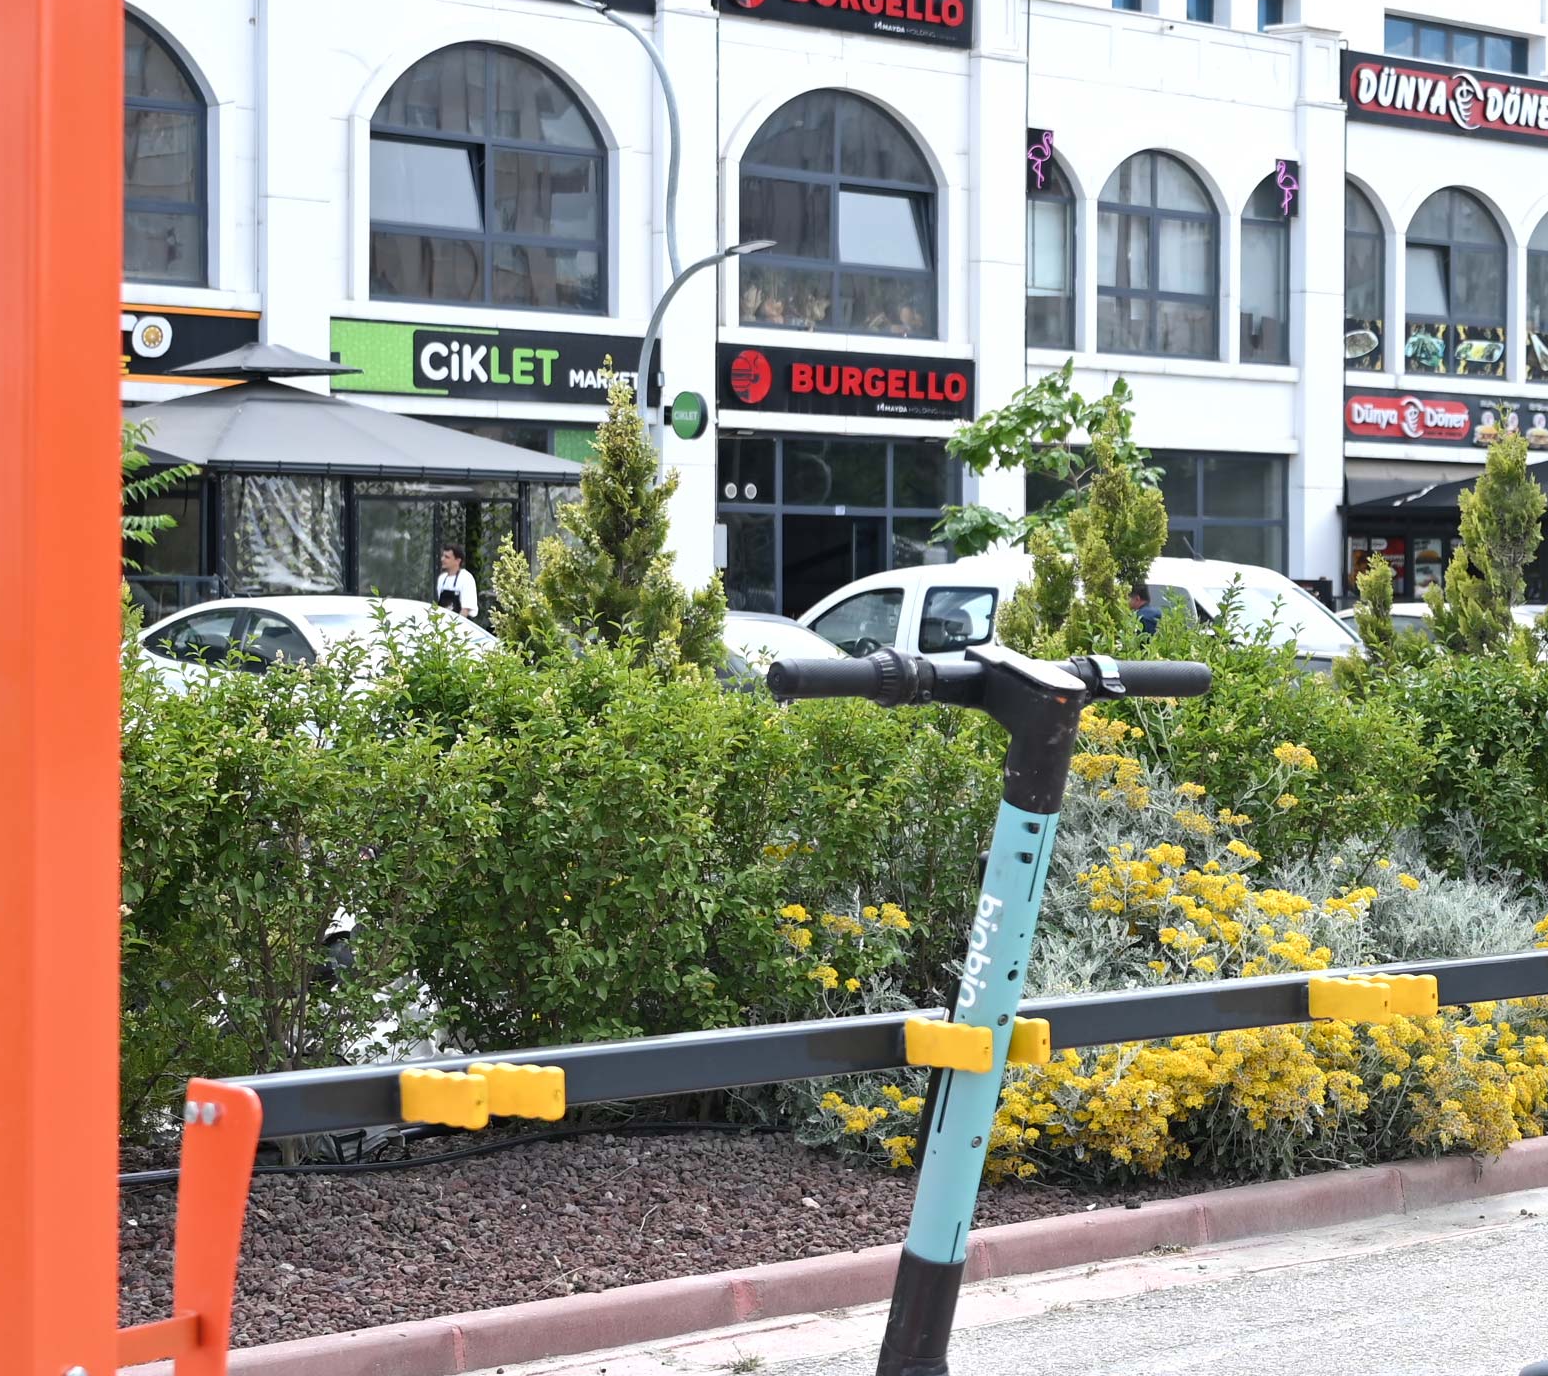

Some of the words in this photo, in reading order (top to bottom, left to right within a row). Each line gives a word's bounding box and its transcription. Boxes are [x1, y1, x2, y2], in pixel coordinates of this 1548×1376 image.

[1358, 67, 1447, 115] DÜNYA
[791, 362, 968, 402] BURGELLO
[1353, 402, 1399, 429] Dünya
[1424, 407, 1469, 428] Döner
[958, 892, 1003, 1009] binbin
